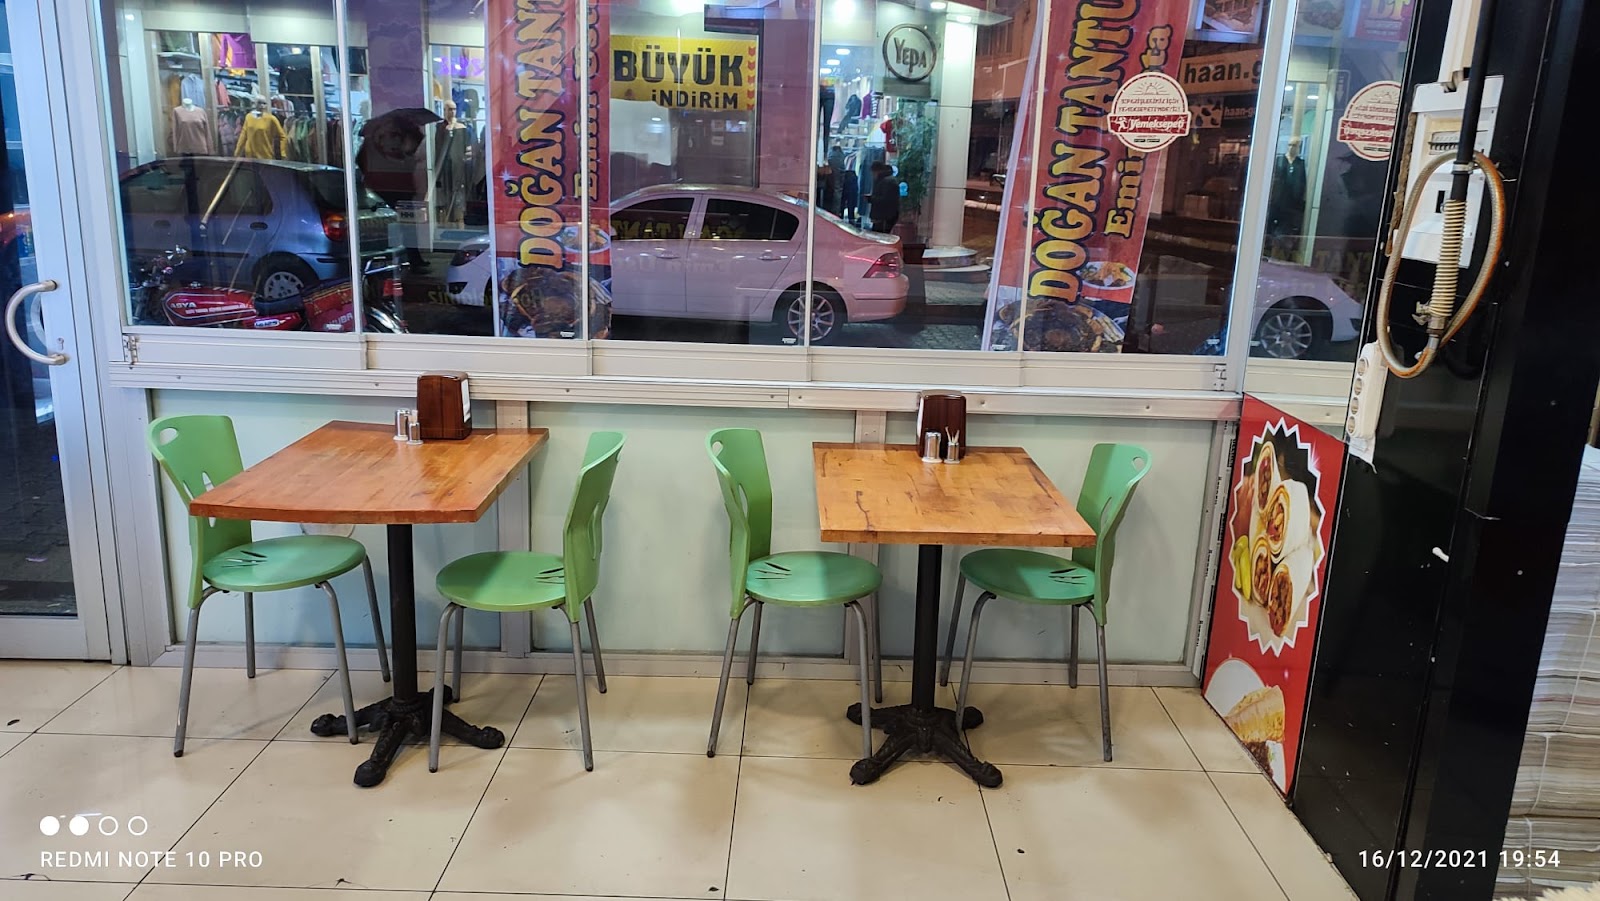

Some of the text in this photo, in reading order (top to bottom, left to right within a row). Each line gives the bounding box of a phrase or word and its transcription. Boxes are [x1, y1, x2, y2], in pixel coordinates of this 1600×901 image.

[613, 45, 744, 86] BÜYÜK
[506, 107, 566, 270] DOĞAN
[1024, 140, 1110, 304] DOĞAN
